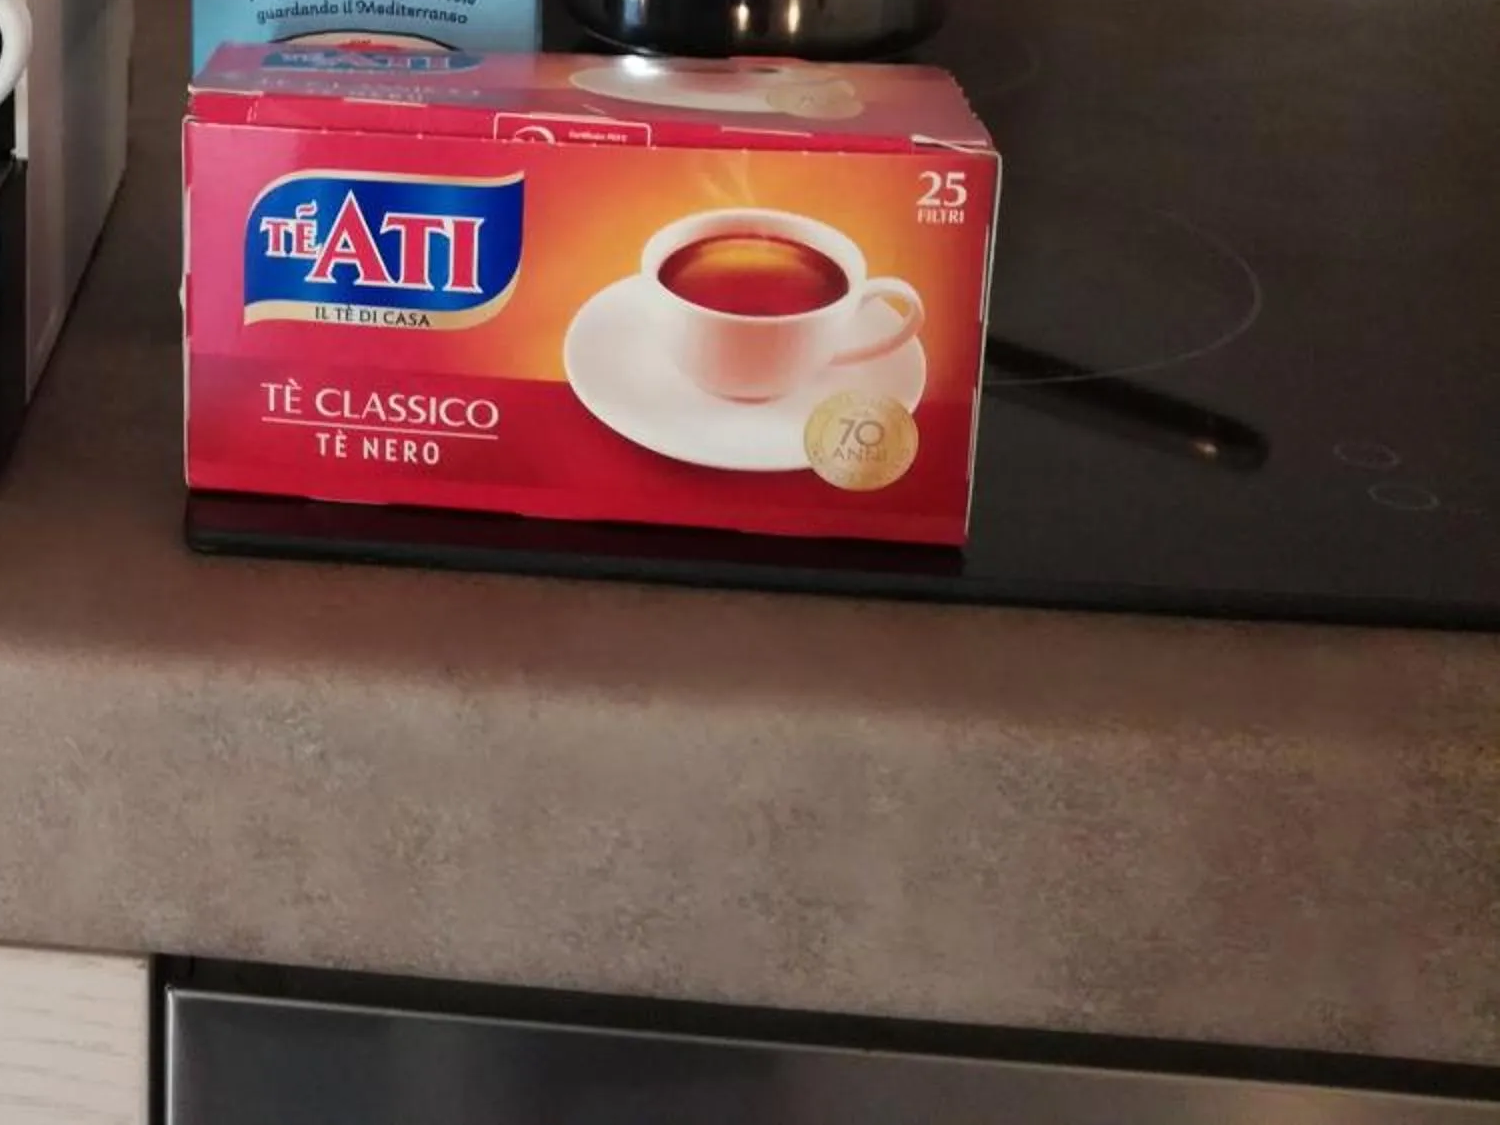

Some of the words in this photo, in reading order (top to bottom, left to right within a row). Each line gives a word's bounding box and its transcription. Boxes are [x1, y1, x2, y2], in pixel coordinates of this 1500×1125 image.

[256, 0, 338, 24] guardando
[343, 0, 353, 14] il
[355, 0, 469, 24] Mediterraneo
[916, 171, 967, 206] 25
[917, 208, 965, 224] FILTRI
[304, 188, 485, 294] ATI
[314, 306, 330, 319] IL
[334, 305, 355, 322] TÈ
[359, 309, 379, 322] DI
[383, 311, 431, 327] CASA
[260, 378, 302, 415] TÈ
[315, 388, 500, 429] CLASSICO
[315, 429, 348, 459] TÈ
[362, 437, 440, 465] NERO
[837, 418, 886, 447] 70
